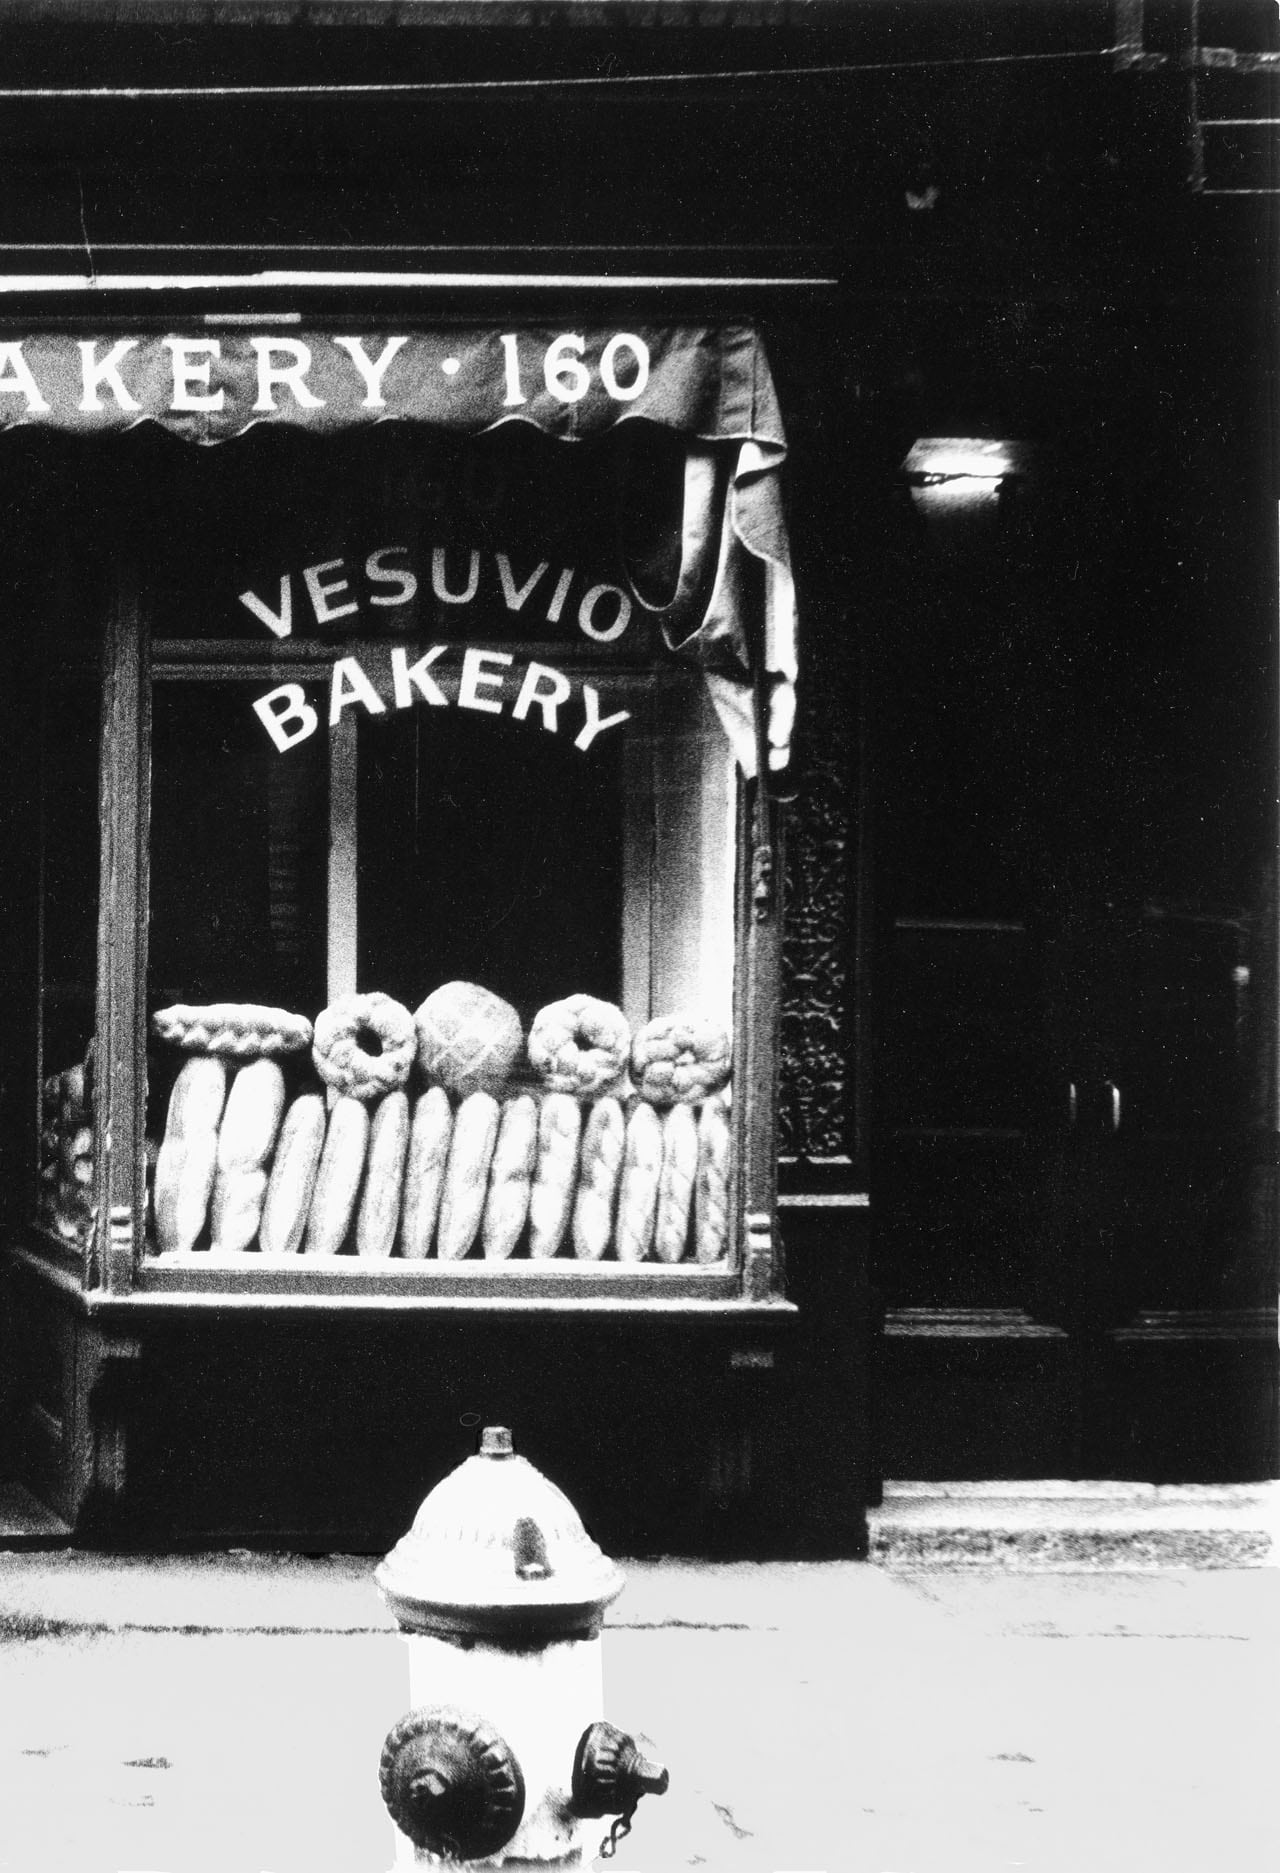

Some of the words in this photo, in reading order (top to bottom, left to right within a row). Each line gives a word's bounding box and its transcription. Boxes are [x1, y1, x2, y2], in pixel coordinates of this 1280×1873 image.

[499, 332, 652, 408] 160
[239, 547, 632, 642] VESUVIO
[252, 645, 630, 754] BAKERY
